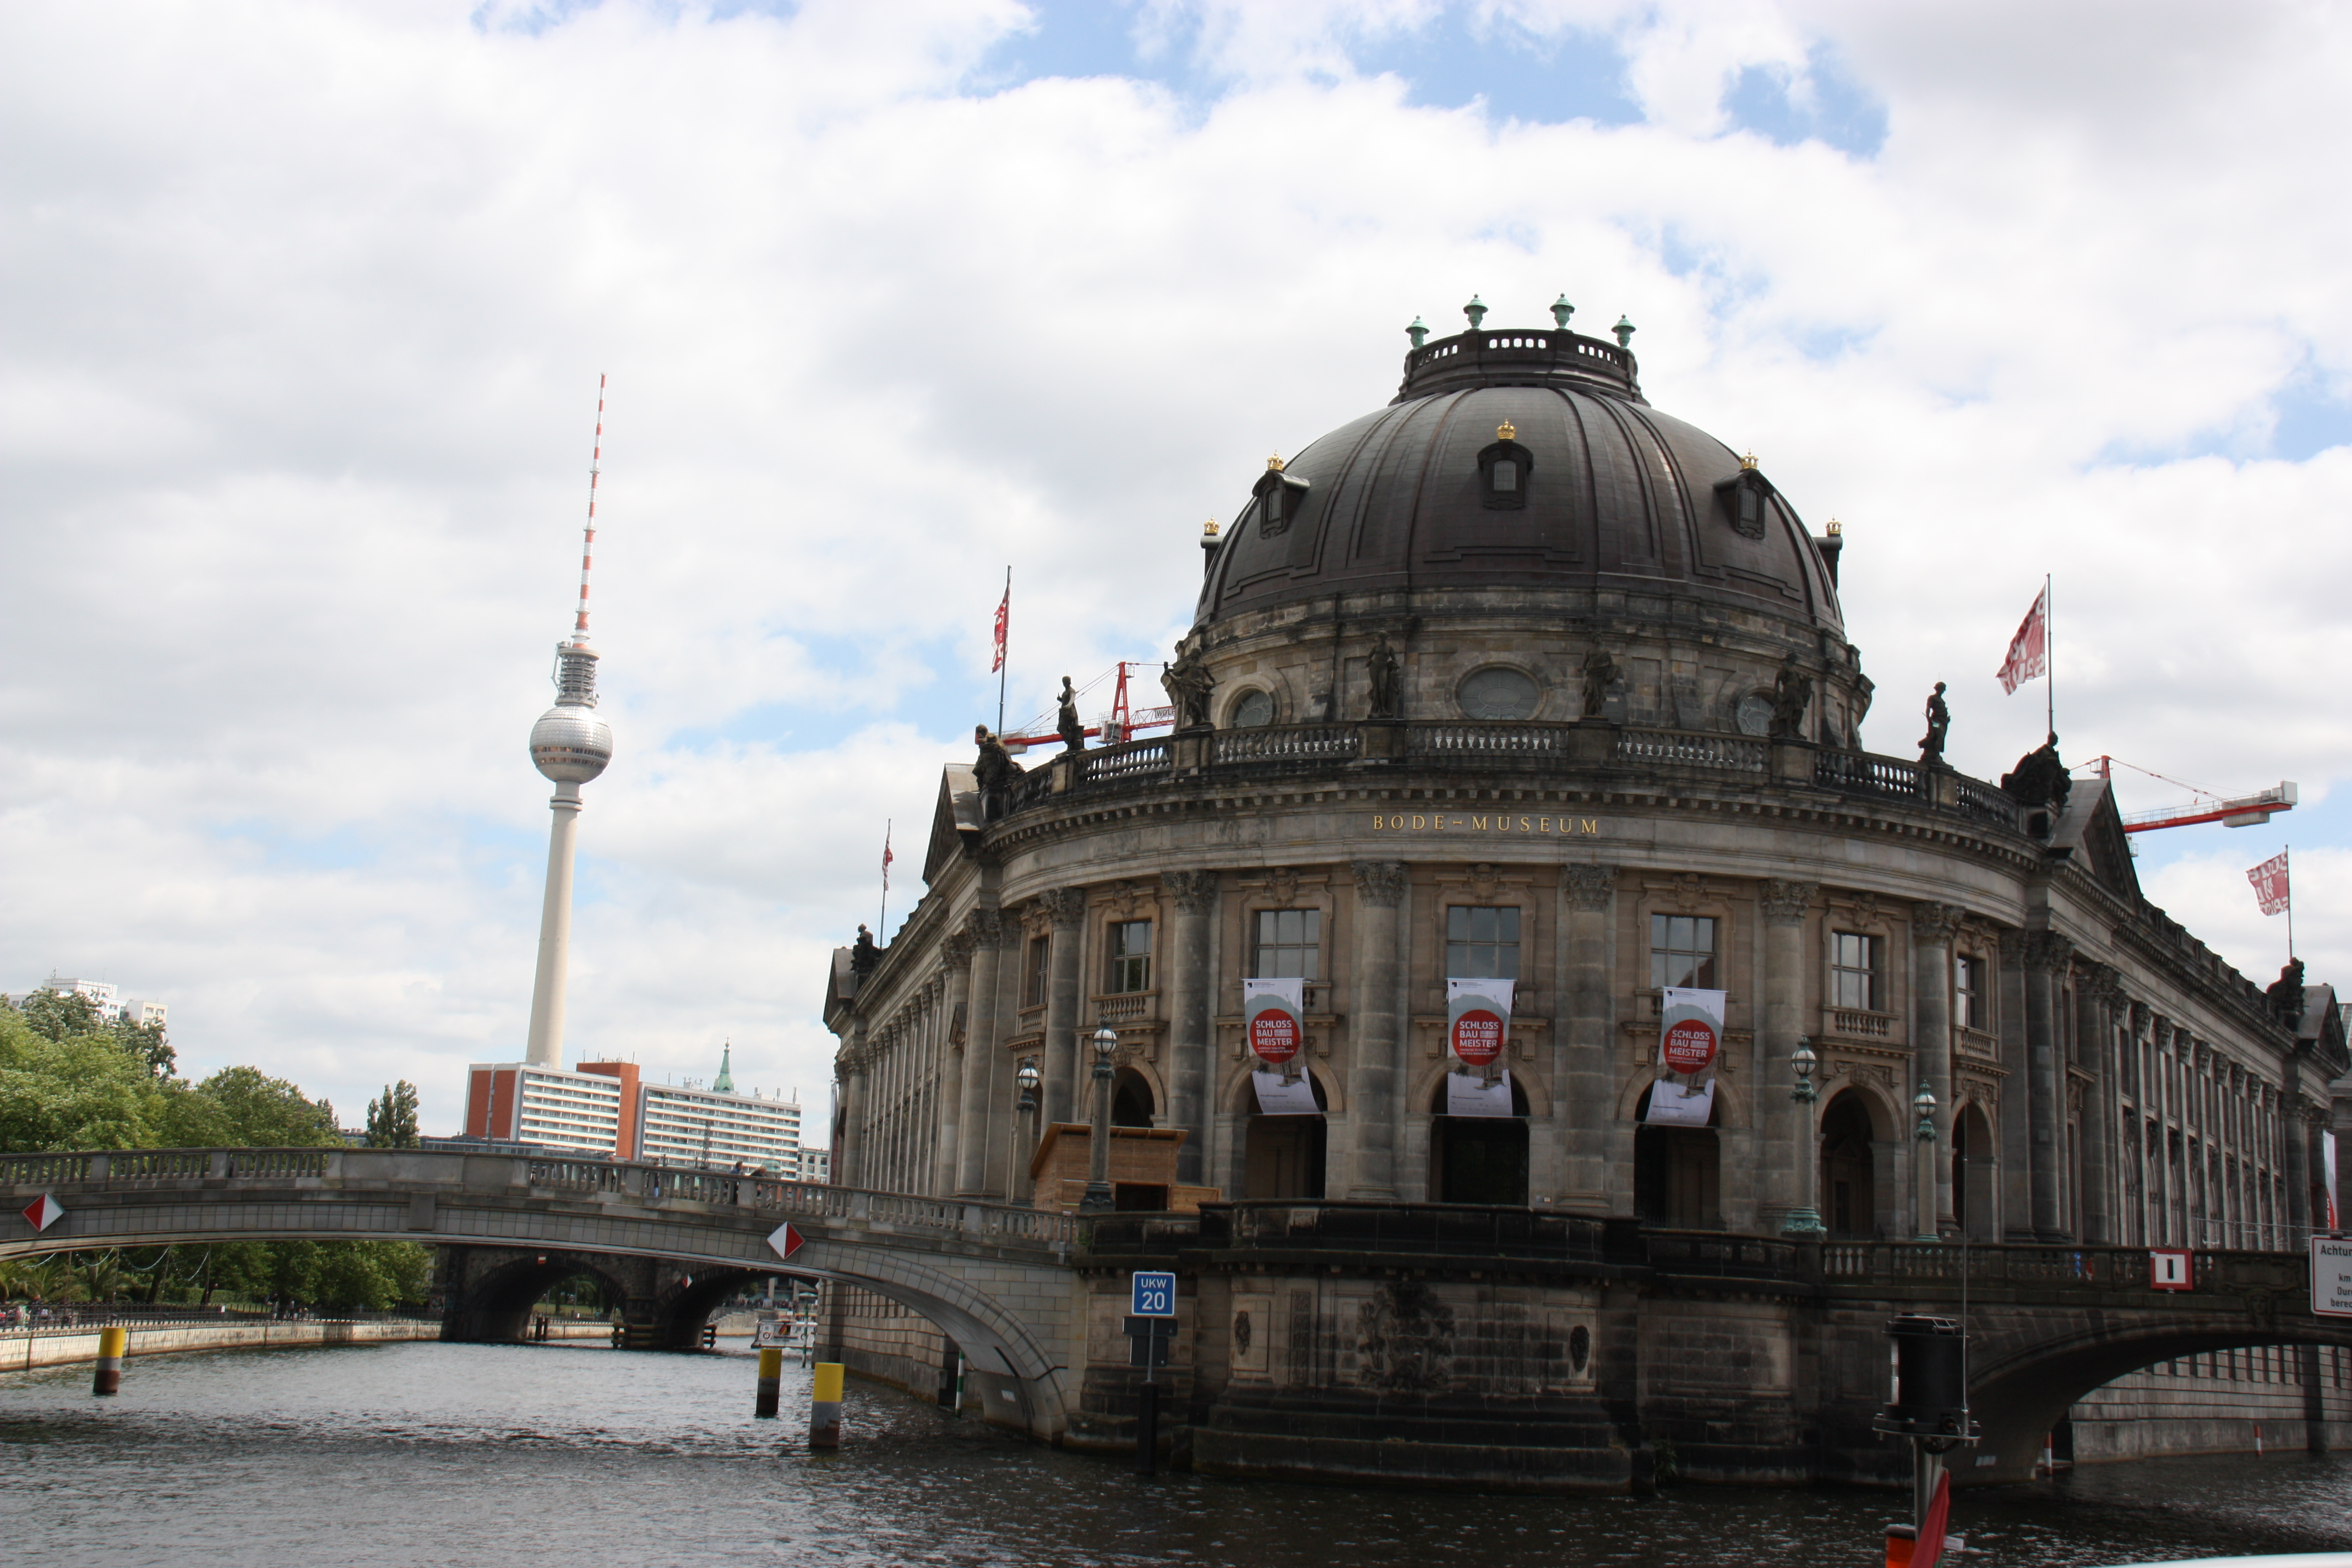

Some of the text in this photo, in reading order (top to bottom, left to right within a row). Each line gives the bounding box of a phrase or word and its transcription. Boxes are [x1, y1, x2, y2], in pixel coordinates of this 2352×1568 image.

[1373, 815, 1597, 834] BODE-MUSEUM
[1460, 1021, 1499, 1030] SCHLOSS
[1460, 1030, 1478, 1038] BAU
[1672, 1030, 1710, 1040] SCHLOSS
[1460, 1039, 1497, 1047] MEISTER
[1670, 1038, 1689, 1047] BAU
[1669, 1047, 1707, 1057] MEISTER
[2339, 1273, 2351, 1282] km
[1141, 1278, 1166, 1288] UKW
[2337, 1287, 2352, 1295] Dur
[1142, 1291, 1164, 1310] 20
